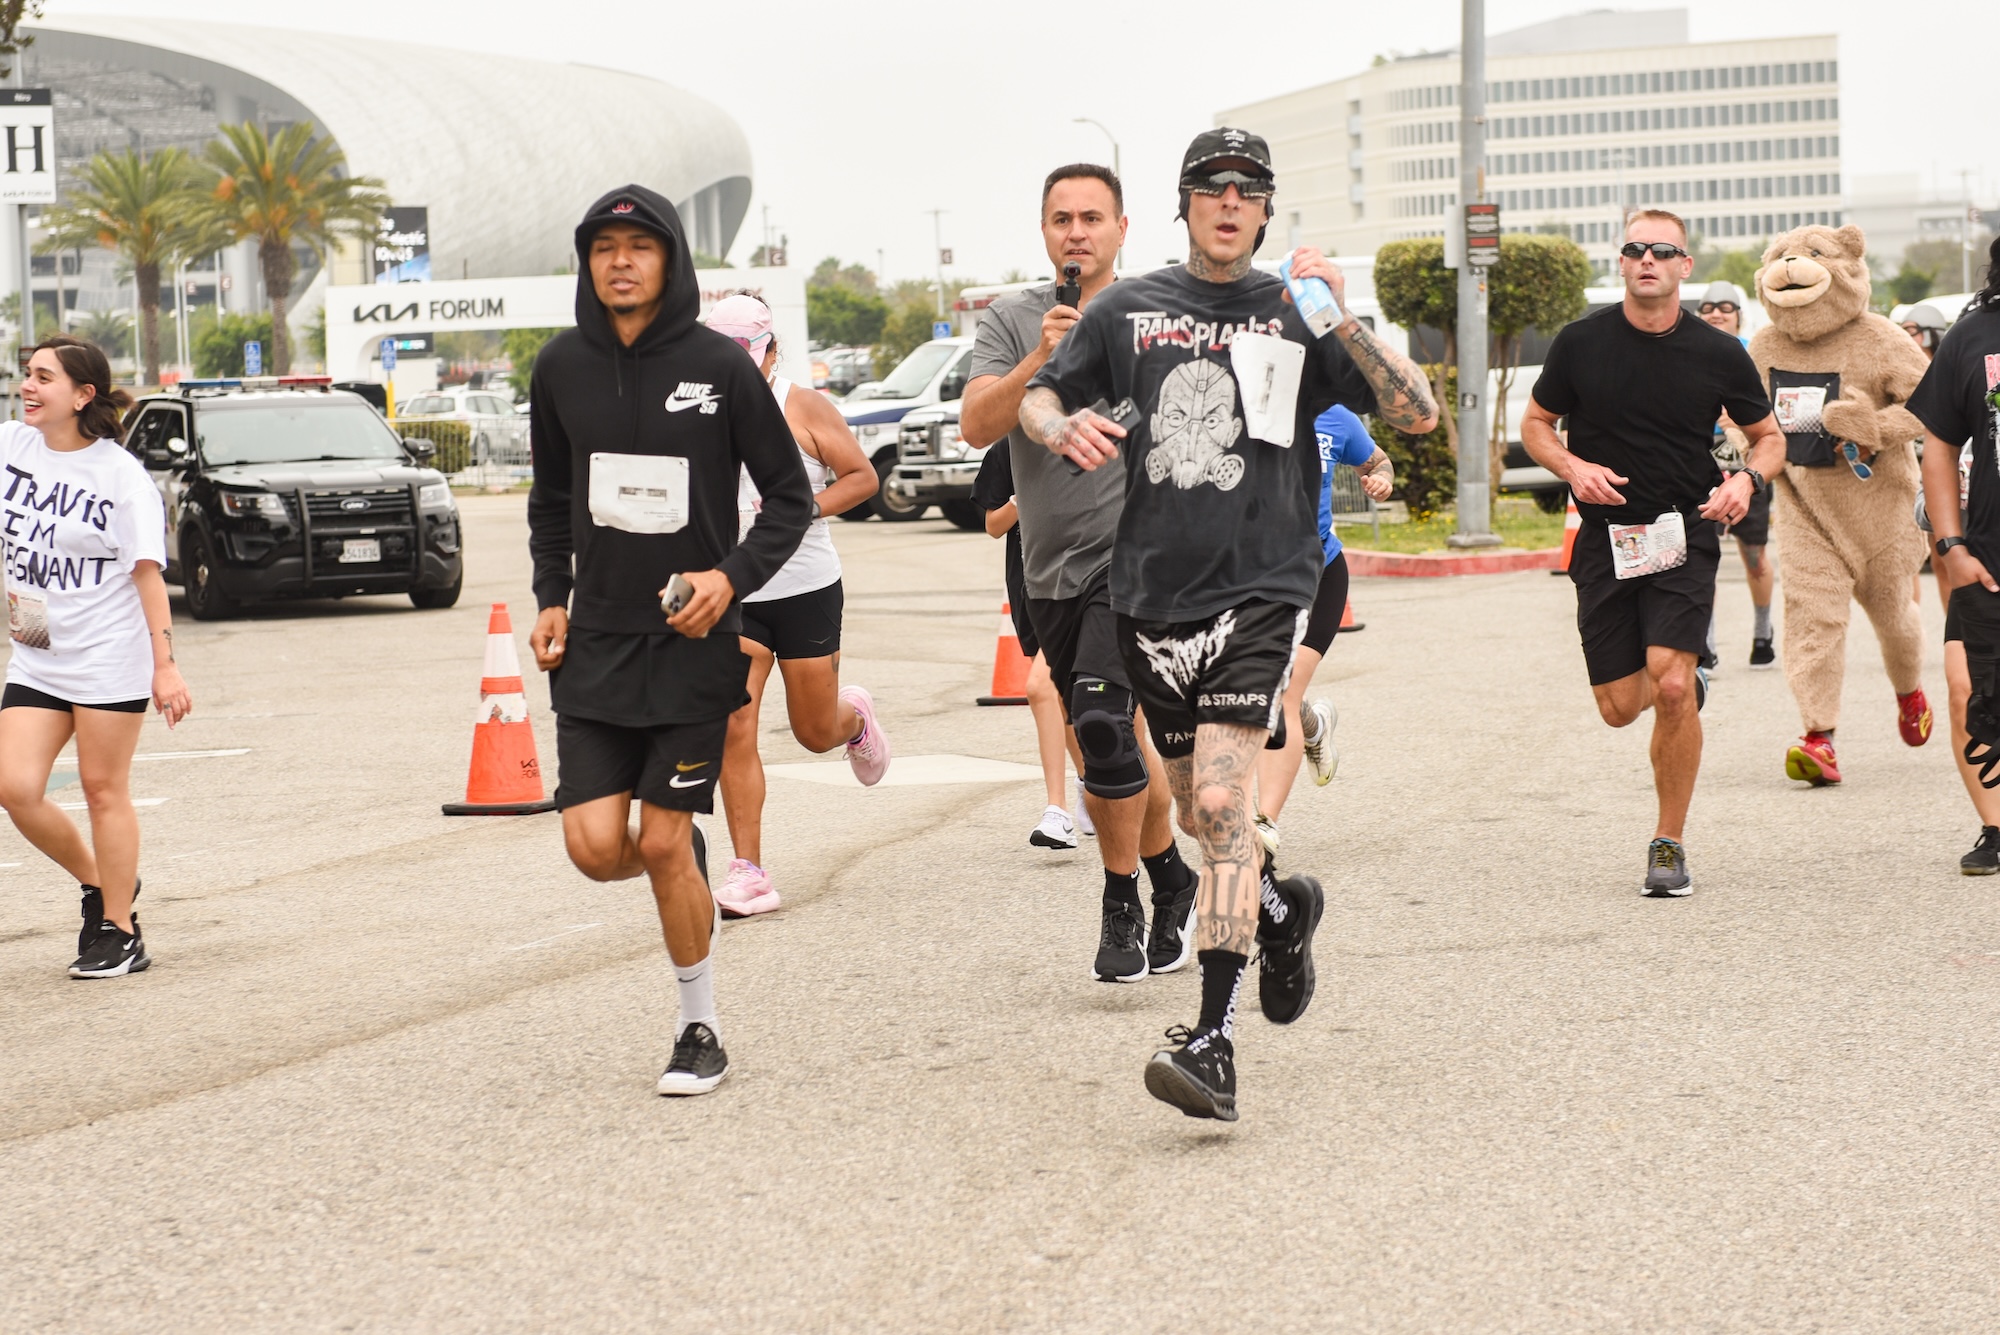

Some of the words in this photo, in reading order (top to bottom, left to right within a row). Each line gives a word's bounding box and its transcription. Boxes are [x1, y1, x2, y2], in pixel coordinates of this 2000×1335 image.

[3, 125, 48, 173] H
[354, 303, 419, 323] KIA
[430, 298, 504, 320] FORUM
[674, 381, 714, 399] NIKE
[699, 400, 719, 415] SB
[4, 508, 56, 549] I'M
[1660, 550, 1678, 566] VIP
[1212, 693, 1268, 707] STRAPS
